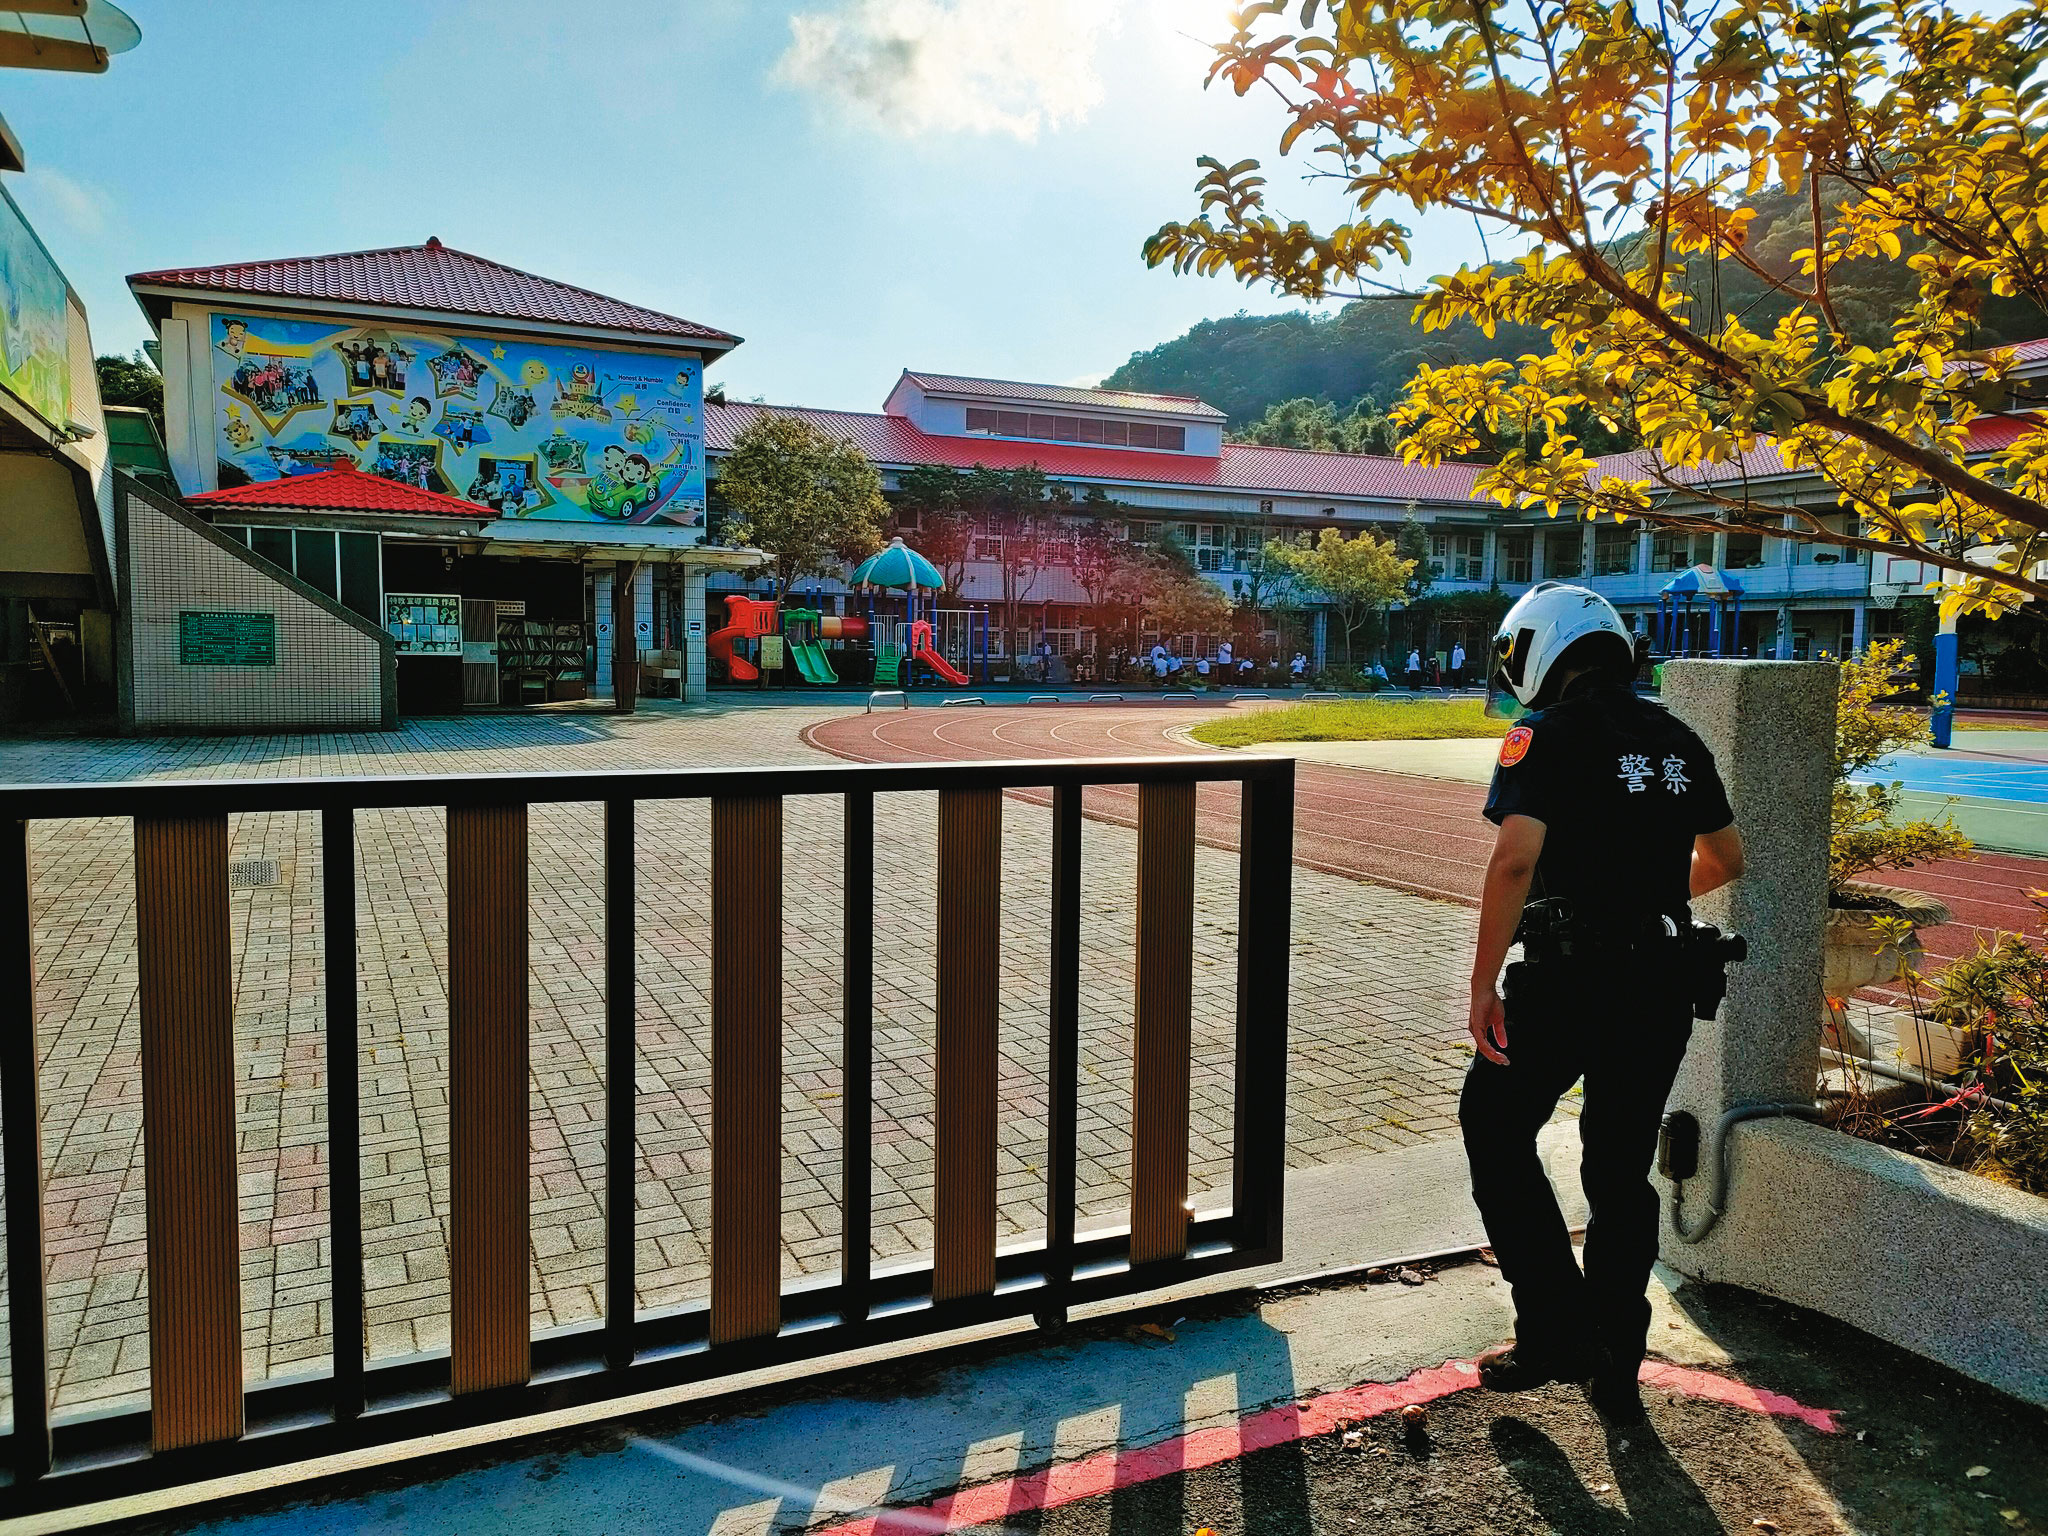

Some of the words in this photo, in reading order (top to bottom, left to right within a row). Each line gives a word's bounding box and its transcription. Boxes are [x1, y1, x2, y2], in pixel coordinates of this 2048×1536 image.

[643, 376, 664, 384] Humble
[656, 399, 691, 408] Confidence
[667, 430, 700, 440] Technology
[659, 462, 698, 471] Humanities
[1616, 753, 1692, 795] 警察
